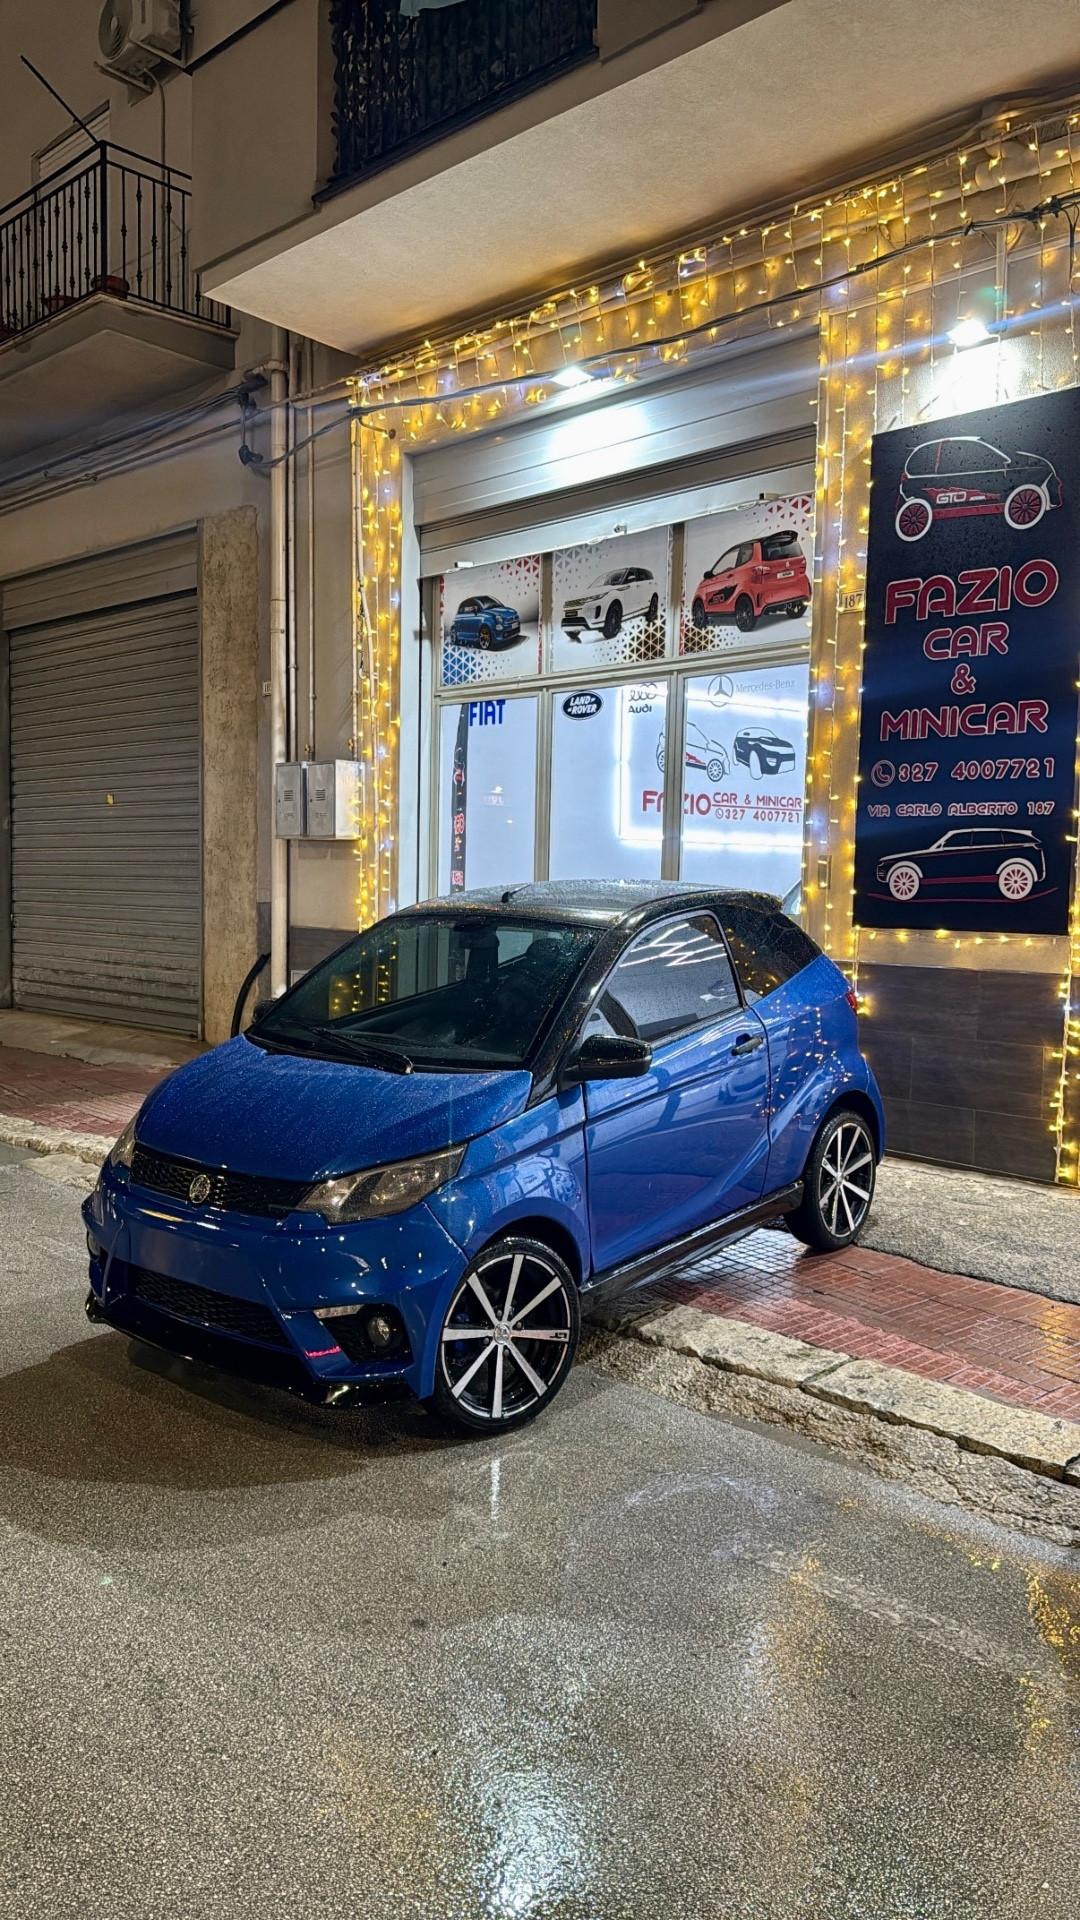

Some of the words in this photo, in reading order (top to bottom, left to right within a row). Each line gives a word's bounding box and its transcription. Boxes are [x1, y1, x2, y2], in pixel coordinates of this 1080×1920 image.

[885, 559, 1059, 625] FAZIO
[845, 593, 863, 608] 187
[923, 621, 1009, 661] CAR
[736, 680, 796, 693] Mercedes-Benz
[951, 663, 976, 695] &
[569, 695, 593, 706] LAND
[628, 704, 652, 713] Audi
[469, 700, 506, 726] FIAT
[571, 703, 597, 715] ROVER
[880, 699, 1049, 741] MINICAR
[899, 761, 939, 783] 327
[951, 757, 1055, 781] 4007721
[713, 792, 738, 805] CAR
[744, 794, 752, 805] &
[756, 794, 803, 808] MINICAR
[725, 809, 746, 821] 327
[753, 809, 800, 823] 4007721
[867, 804, 891, 817] VIA
[896, 803, 942, 817] CARLO
[948, 801, 1018, 816] ALBERTO
[1027, 801, 1055, 815] 187
